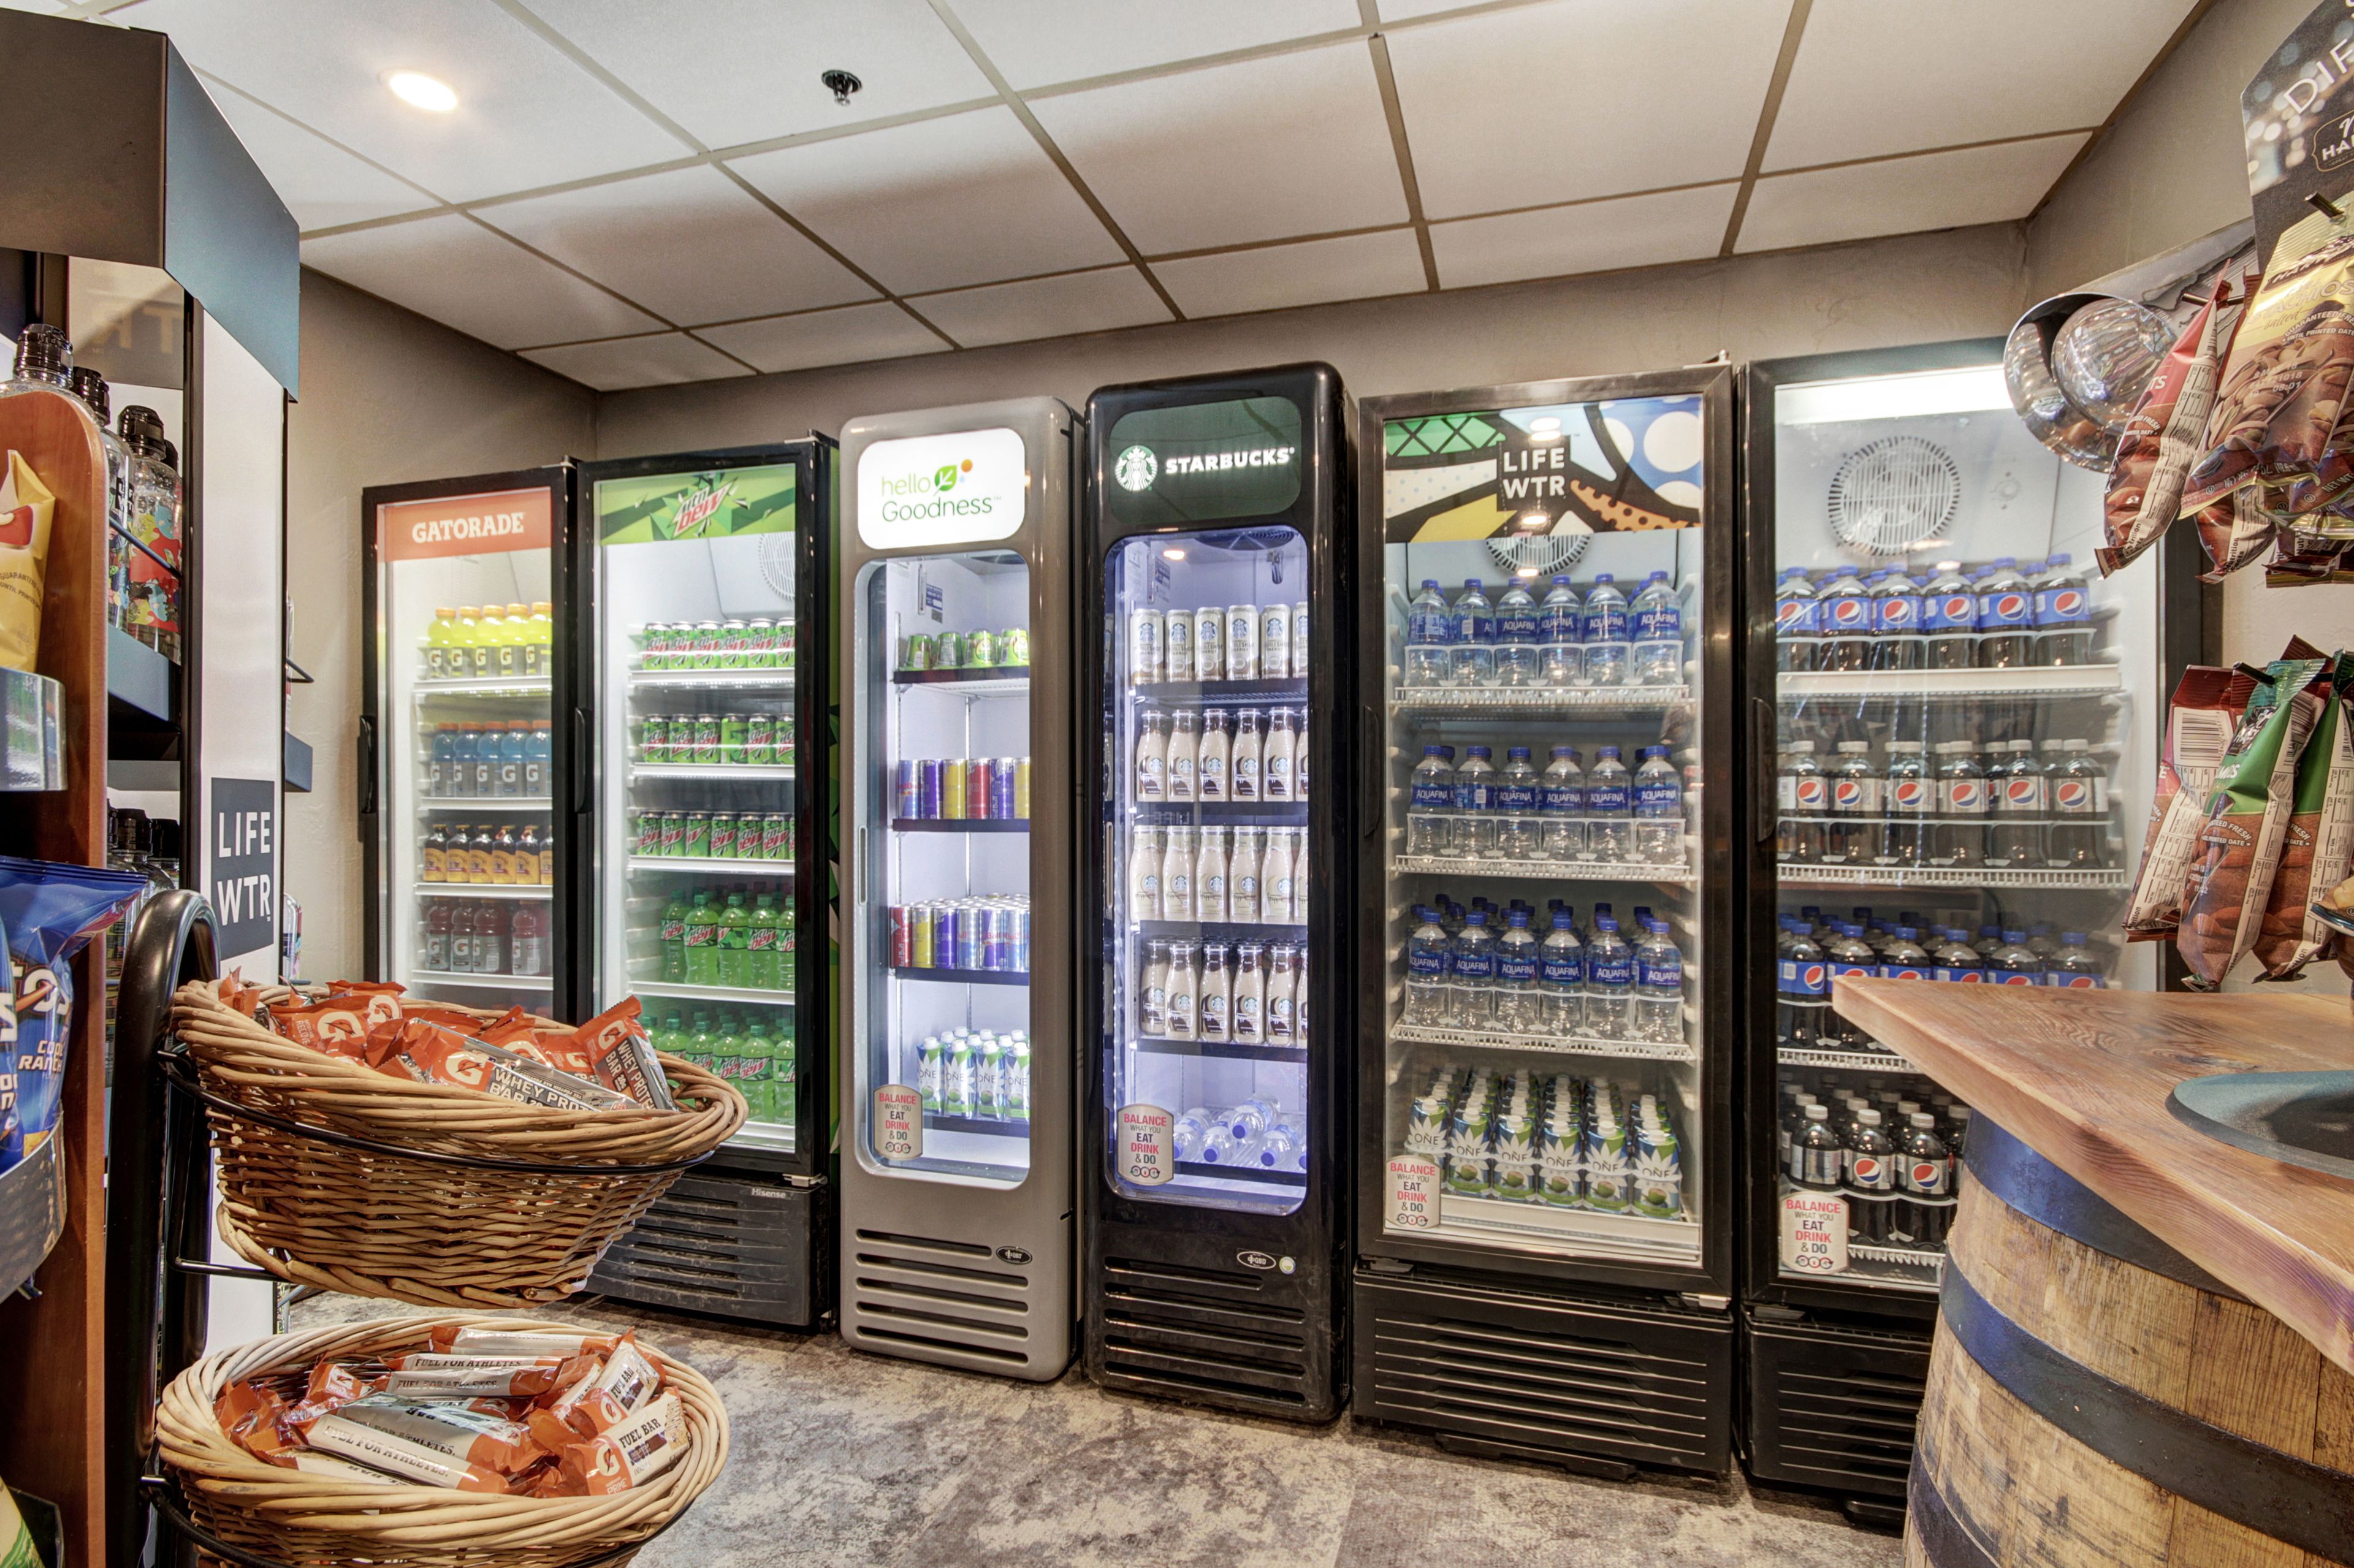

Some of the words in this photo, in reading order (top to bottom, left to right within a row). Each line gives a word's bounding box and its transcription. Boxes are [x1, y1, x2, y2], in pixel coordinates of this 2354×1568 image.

[2285, 310, 2339, 337] GUARANTEED
[2306, 327, 2336, 337] PRINTED
[1165, 447, 1291, 474] STARBUCKS
[1503, 447, 1566, 473] LIFE
[882, 473, 931, 497] hello
[1503, 475, 1566, 500] WTR
[2322, 482, 2341, 493] NET
[882, 497, 992, 522] Goodness
[412, 512, 525, 543] GATORADE
[1503, 620, 1536, 631] AQUAFINA
[1416, 789, 1449, 801] AQUAFINA
[1499, 791, 1533, 802] AQUAFINA
[1547, 793, 1582, 804] AQUAFINA
[1590, 793, 1626, 804] AQUAFINA
[1640, 790, 1677, 801] AQUAFINA
[219, 812, 271, 858] LIFE
[2228, 822, 2253, 840] FRESH
[454, 939, 468, 956] G
[1457, 959, 1490, 971] AQUAFINA
[1502, 964, 1536, 975] AQUAFINA
[1545, 965, 1580, 977] AQUAFINA
[318, 1011, 365, 1042] G
[598, 1019, 628, 1050] G
[617, 1040, 639, 1074] WHEY
[445, 1051, 487, 1085] G
[604, 1050, 622, 1078] BAR
[495, 1068, 545, 1098] WHEY
[879, 1092, 916, 1105] BALANCE
[890, 1111, 904, 1121] EAT
[1124, 1113, 1167, 1127] BALANCE
[885, 1121, 910, 1132] DRINK
[1130, 1124, 1147, 1133] WHAT
[889, 1131, 895, 1140] &
[896, 1131, 907, 1140] DO
[1137, 1133, 1153, 1143] EAT
[1131, 1143, 1159, 1154] DRINK
[1135, 1154, 1141, 1163] &
[1143, 1154, 1156, 1164] DO
[1390, 1162, 1436, 1176] BALANCE
[1403, 1181, 1421, 1192] EAT
[1397, 1191, 1427, 1203] DRINK
[1401, 1201, 1408, 1211] &
[1410, 1203, 1423, 1212] DO
[1786, 1199, 1841, 1214] BALANCE
[1794, 1211, 1816, 1220] WHAT
[1818, 1212, 1834, 1221] YOU
[1803, 1220, 1824, 1230] EAT
[1796, 1230, 1832, 1243] DRINK
[1801, 1242, 1809, 1253] &
[1811, 1243, 1827, 1254] DO
[415, 1358, 441, 1367] FUEL
[619, 1429, 642, 1448] FUEL
[641, 1418, 661, 1435] BAR
[596, 1444, 620, 1477] G
